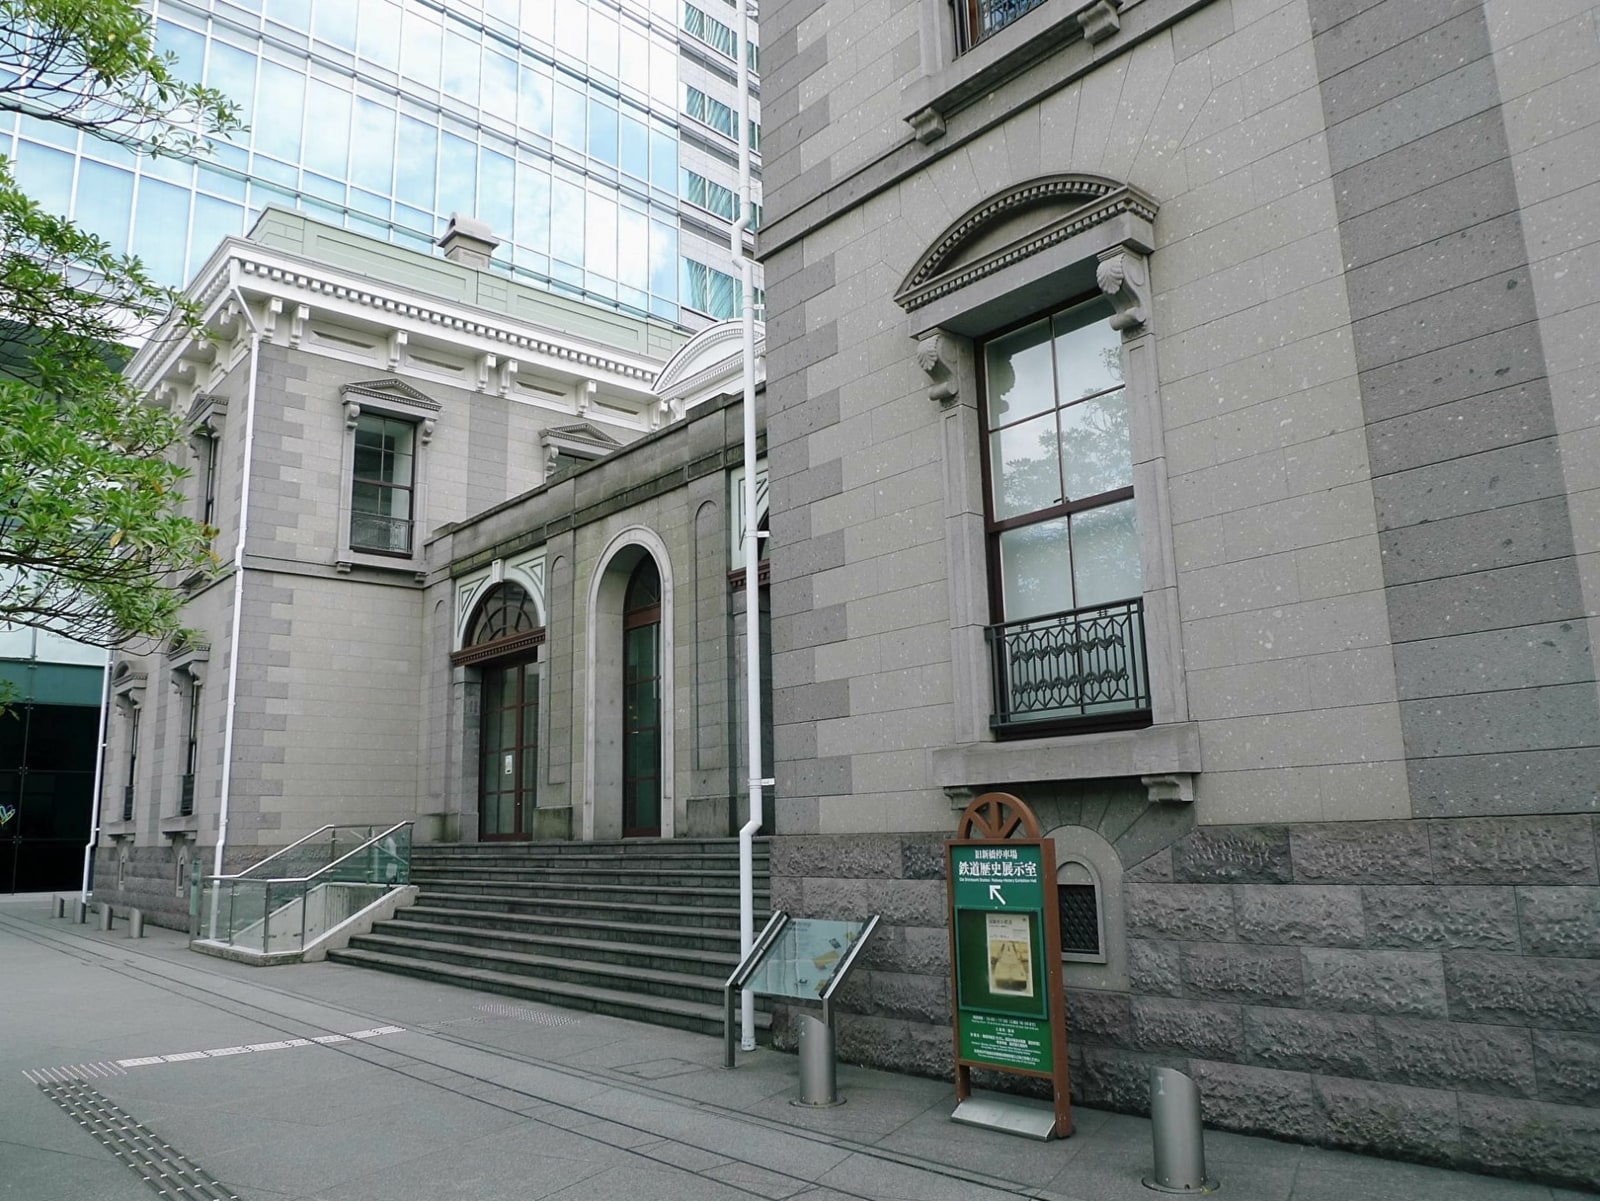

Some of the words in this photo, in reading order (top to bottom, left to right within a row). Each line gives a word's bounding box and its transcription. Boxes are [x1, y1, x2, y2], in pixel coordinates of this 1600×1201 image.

[975, 849, 1018, 860] 旧新橋停車場
[959, 861, 1037, 877] 鉄道歴史展示室
